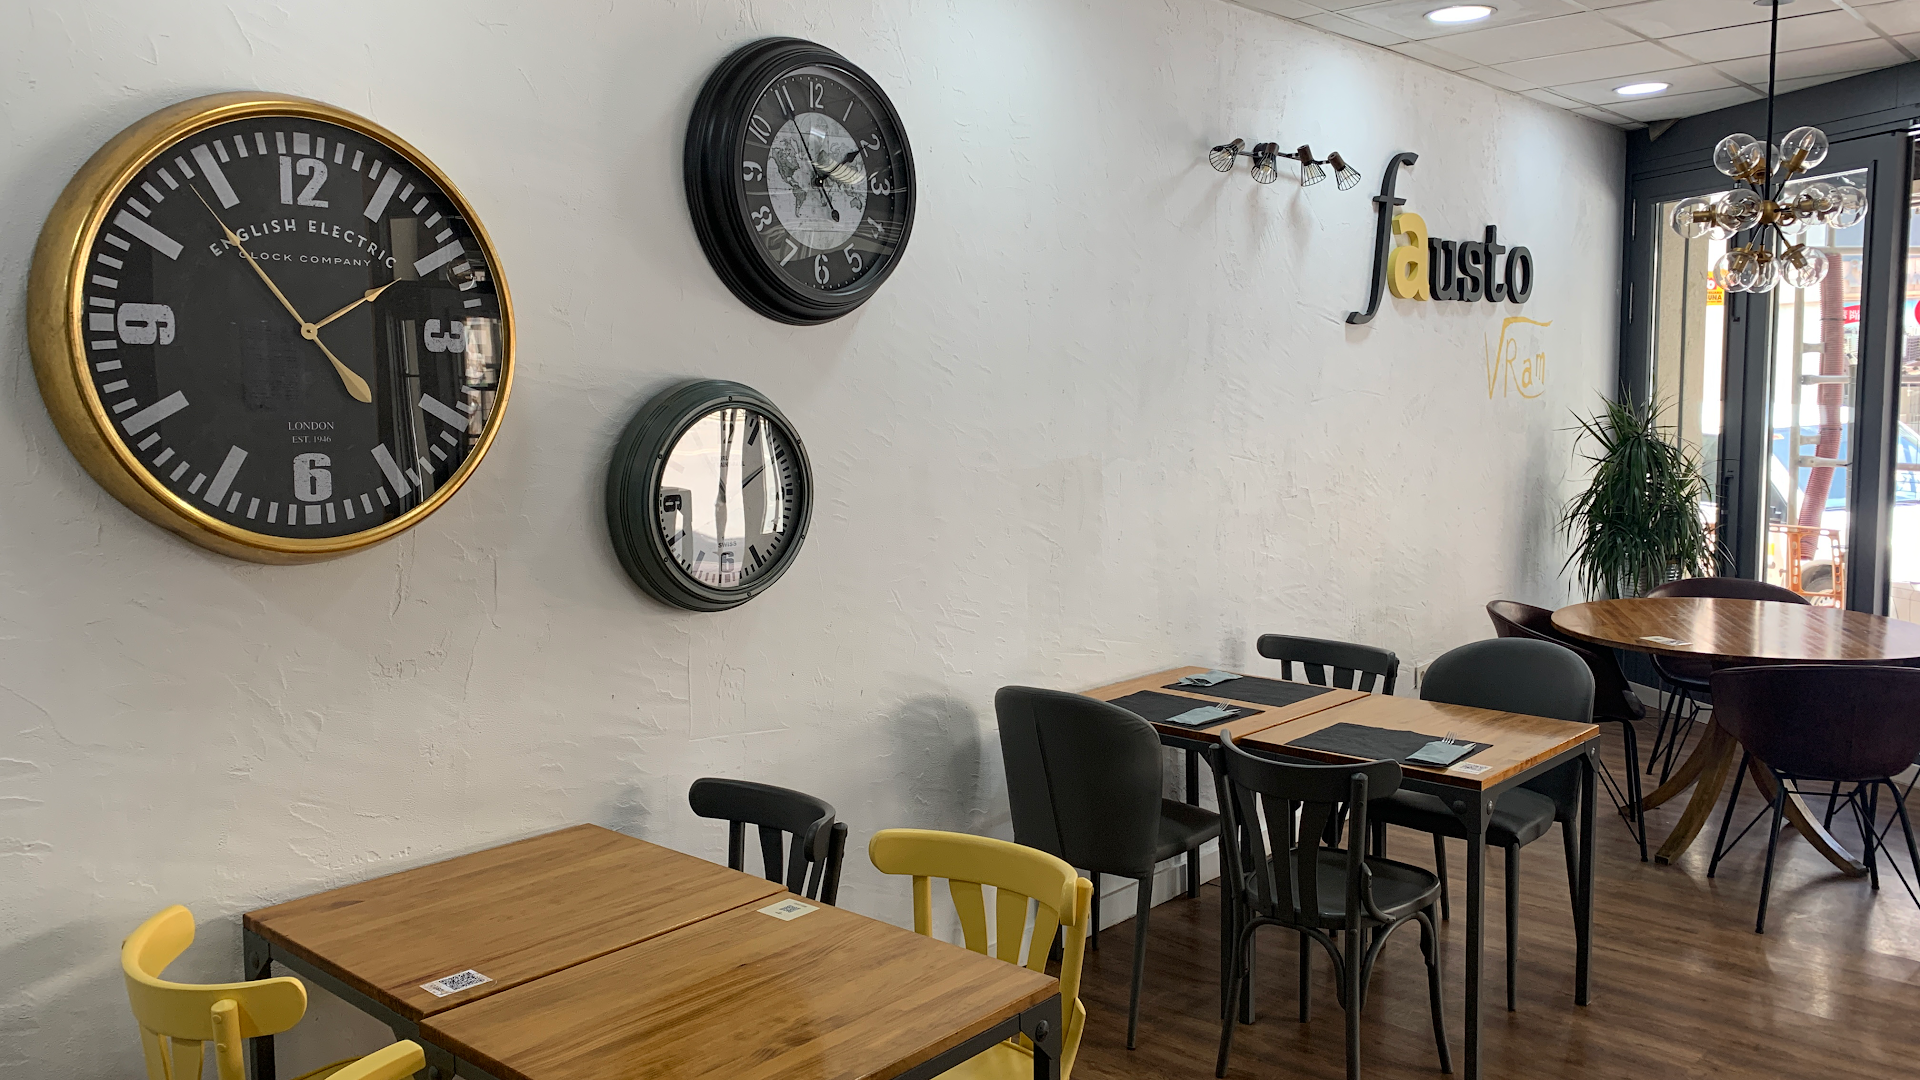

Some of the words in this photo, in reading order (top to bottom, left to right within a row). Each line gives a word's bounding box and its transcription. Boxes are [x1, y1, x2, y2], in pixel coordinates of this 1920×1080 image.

[775, 85, 795, 116] 11
[809, 81, 824, 109] 12
[842, 100, 854, 122] 1
[748, 114, 772, 145] 10
[860, 133, 881, 158] 2
[279, 155, 330, 209] 12
[743, 160, 763, 182] 9
[870, 176, 892, 197] 3
[751, 205, 773, 232] 8
[209, 218, 297, 257] ENGLISH
[308, 219, 397, 269] ELECTRIC
[1345, 152, 1534, 324] fausto
[239, 251, 292, 262] CLOCK
[299, 255, 372, 267] COMPANY
[780, 238, 799, 267] 7
[843, 242, 863, 274] 5
[814, 253, 830, 284] 6
[117, 302, 176, 346] 9
[424, 318, 466, 353] 3
[288, 421, 335, 431] LONDON
[292, 435, 312, 444] EST.
[313, 435, 332, 443] 1946
[293, 452, 332, 502] 6
[663, 494, 682, 512] 9
[720, 551, 735, 573] 6
